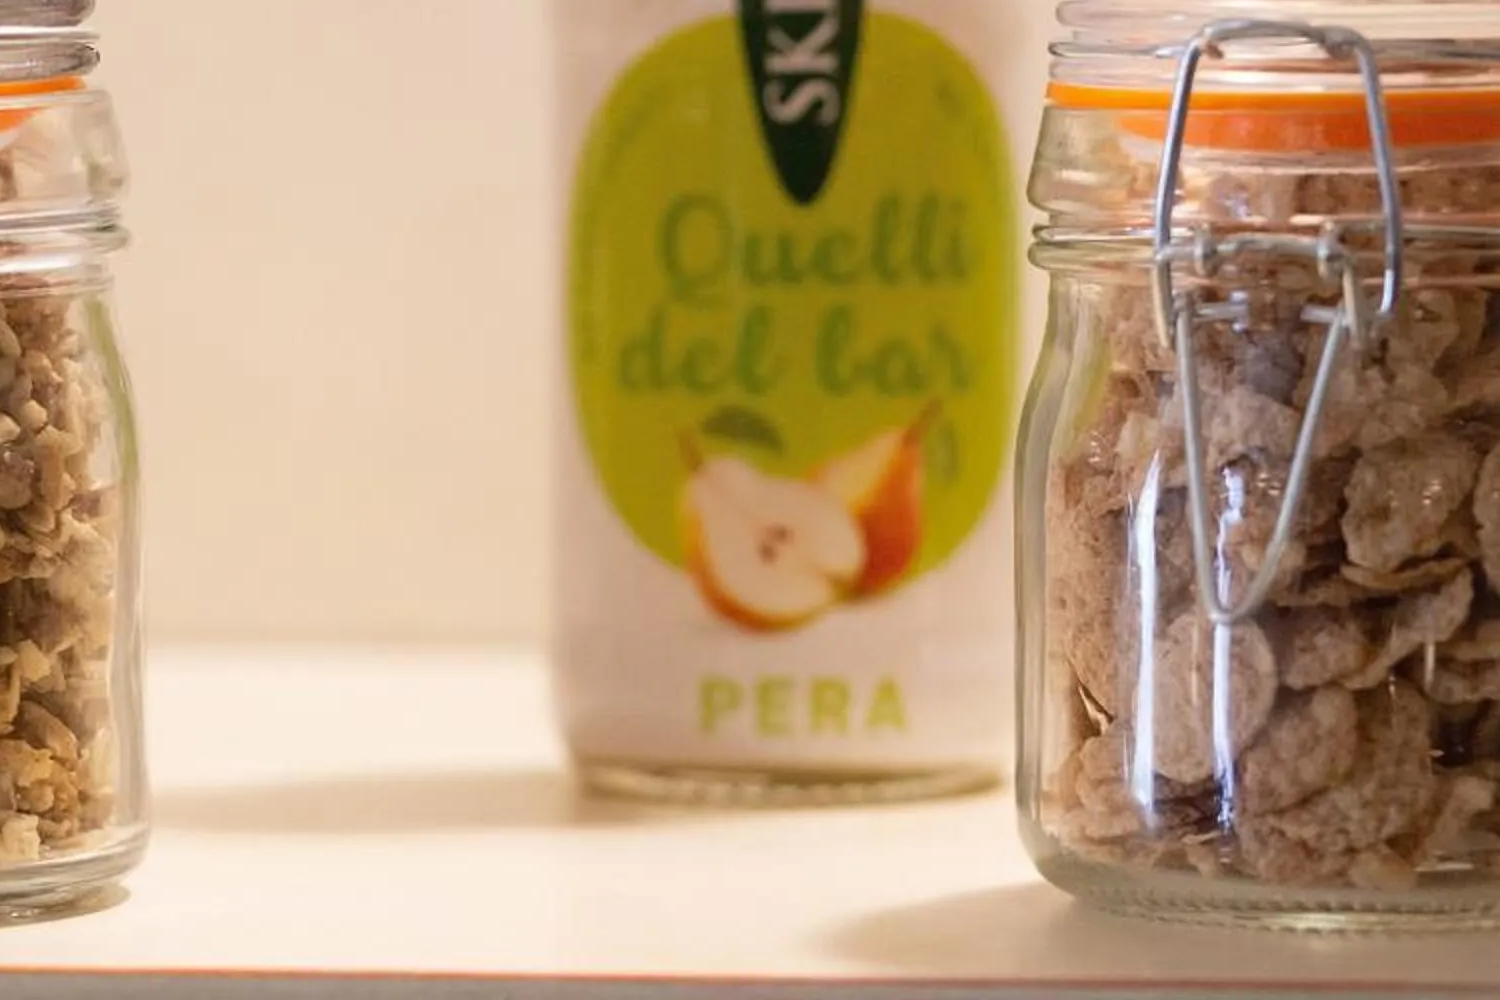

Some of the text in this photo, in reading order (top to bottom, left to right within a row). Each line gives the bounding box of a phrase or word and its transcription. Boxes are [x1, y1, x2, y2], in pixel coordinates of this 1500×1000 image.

[657, 192, 973, 306] Quelli
[618, 303, 972, 397] del bar
[700, 675, 909, 737] PERA
